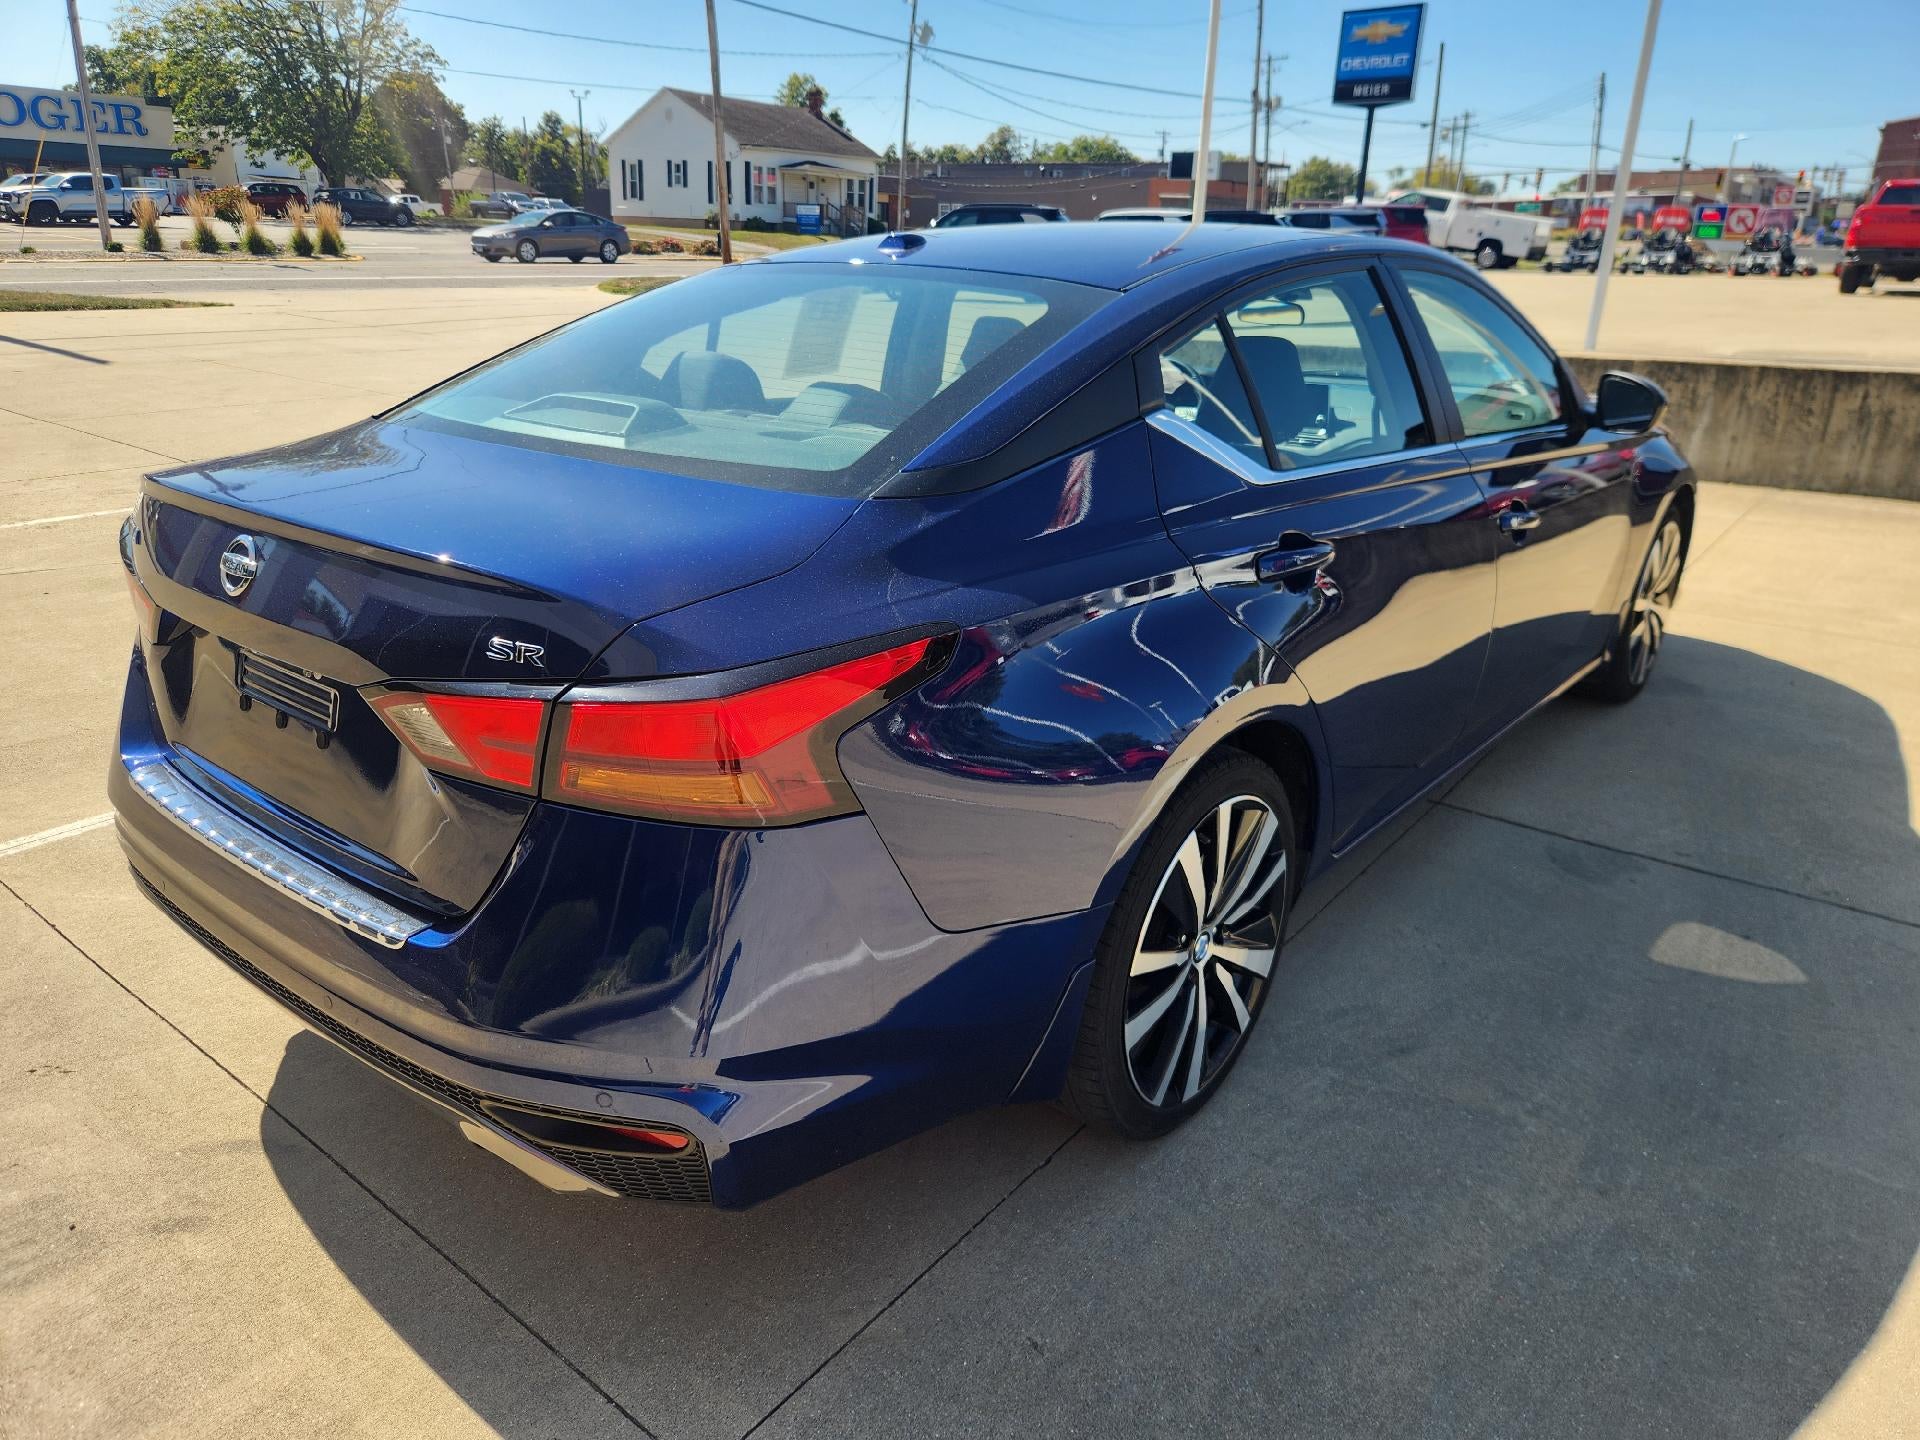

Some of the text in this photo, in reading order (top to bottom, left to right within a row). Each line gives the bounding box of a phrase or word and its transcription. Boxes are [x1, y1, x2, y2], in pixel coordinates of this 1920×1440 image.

[1341, 53, 1410, 71] CHEVROLET
[1352, 83, 1391, 97] MEIER
[223, 557, 249, 575] SSAN
[485, 636, 545, 668] SR
